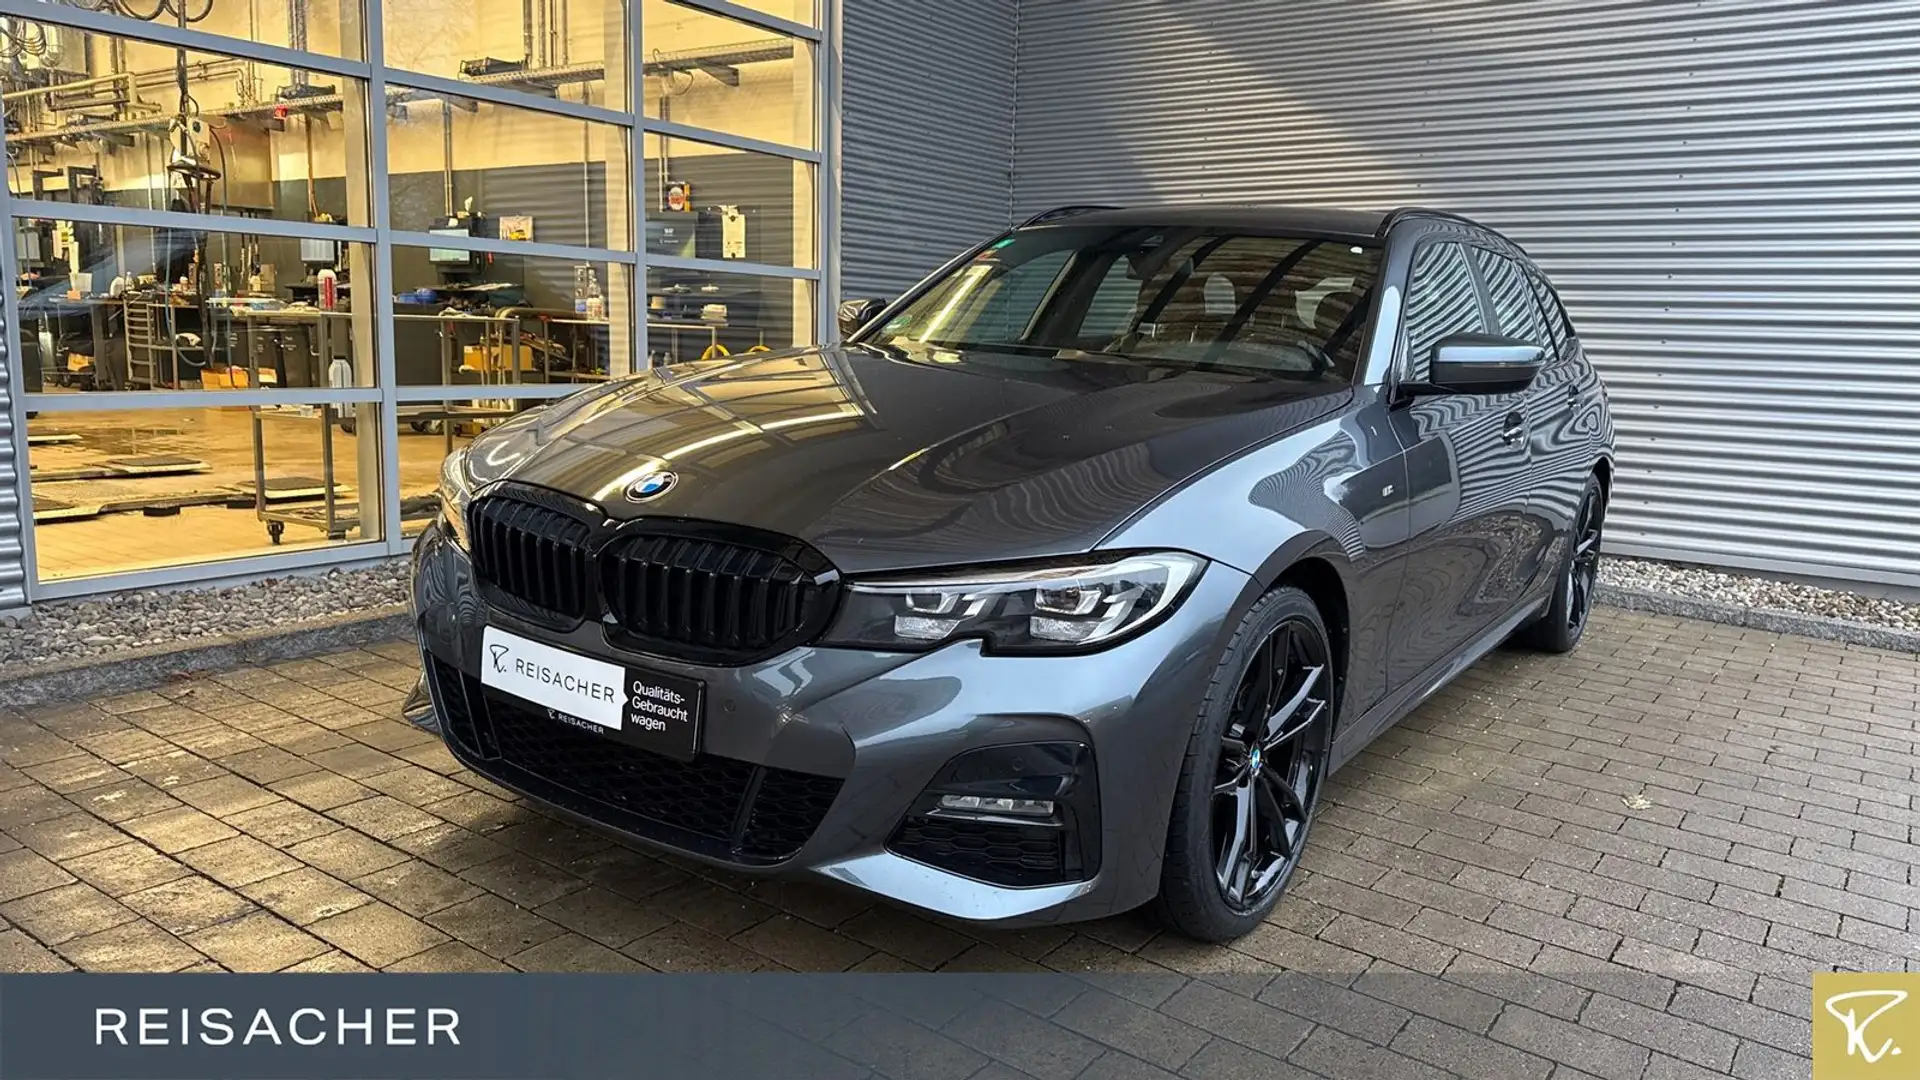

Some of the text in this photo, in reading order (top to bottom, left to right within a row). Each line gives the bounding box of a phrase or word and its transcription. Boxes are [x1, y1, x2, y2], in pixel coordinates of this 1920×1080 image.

[515, 658, 615, 703] REISACHER
[633, 680, 685, 704] Qualitäts-
[632, 696, 688, 722] Gebraucht
[558, 713, 604, 734] REISACHER
[631, 713, 666, 731] wagen
